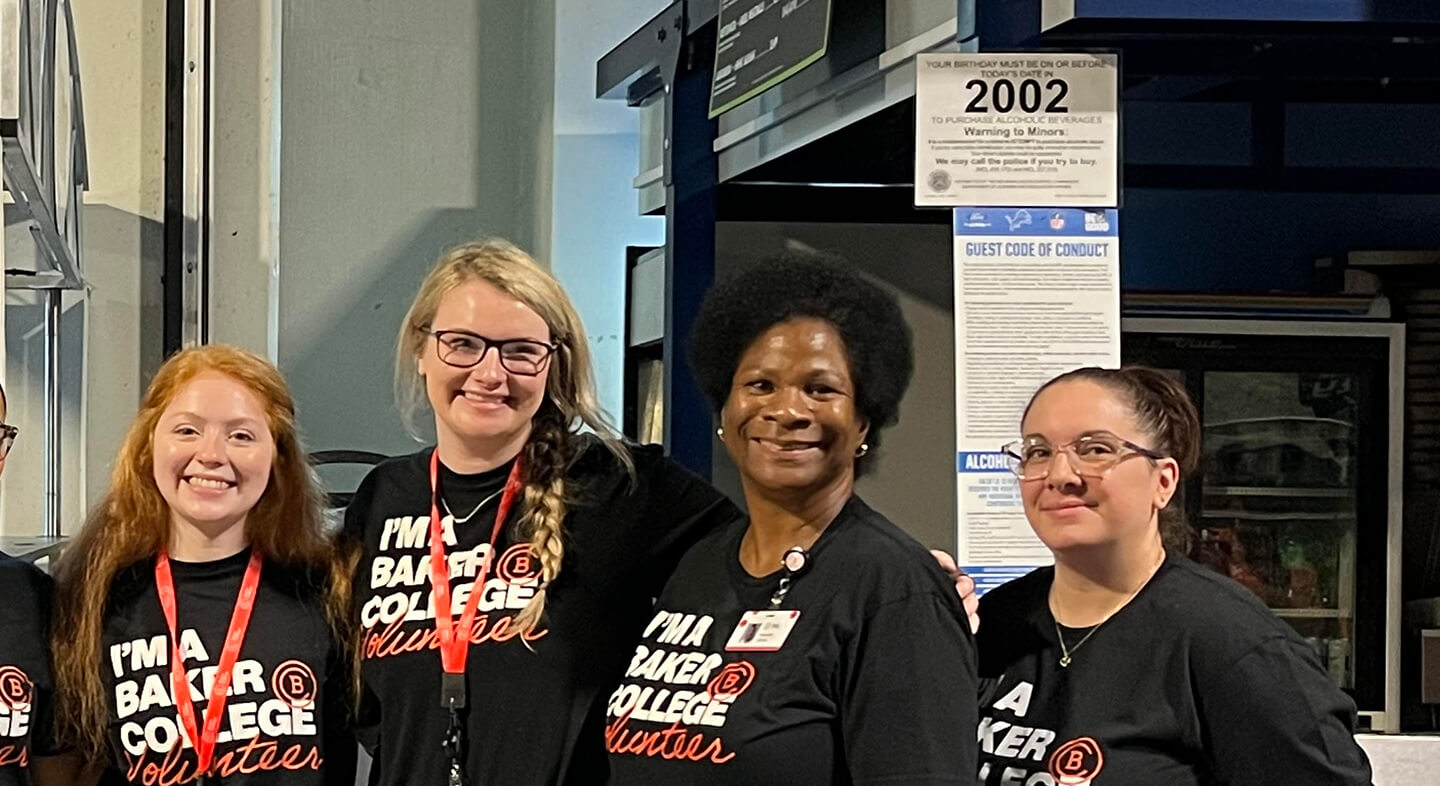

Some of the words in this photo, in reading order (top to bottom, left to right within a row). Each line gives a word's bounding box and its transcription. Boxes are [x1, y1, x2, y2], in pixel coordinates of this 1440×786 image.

[926, 60, 951, 68] YOUR
[954, 60, 996, 68] BIRTHDAY
[1000, 60, 1024, 68] MUST
[1027, 60, 1039, 68] BE
[1040, 60, 1053, 68] ON
[1056, 60, 1069, 68] OR
[1072, 60, 1105, 68] BEFORE
[981, 70, 1017, 78] TODAY'S
[1020, 70, 1041, 78] DATE
[1044, 70, 1053, 78] IN
[965, 78, 1068, 113] 2002
[931, 116, 943, 124] TO
[946, 116, 993, 124] PURCHASE
[996, 116, 1045, 124] ALCOHOLIC
[1048, 116, 1102, 124] BEVERAGES
[964, 127, 1010, 138] Warning
[1013, 128, 1024, 136] to
[1038, 159, 1054, 167] you
[1056, 159, 1067, 167] try
[966, 242, 1002, 257] GUEST
[1005, 242, 1035, 257] CODE
[1038, 242, 1052, 257] OF
[1055, 242, 1109, 257] CONDUCT
[681, 615, 714, 646] A
[110, 635, 168, 678] I'M
[179, 628, 209, 661] A
[992, 681, 1034, 717] A
[605, 704, 735, 764] lunteer
[977, 717, 1056, 761] KER
